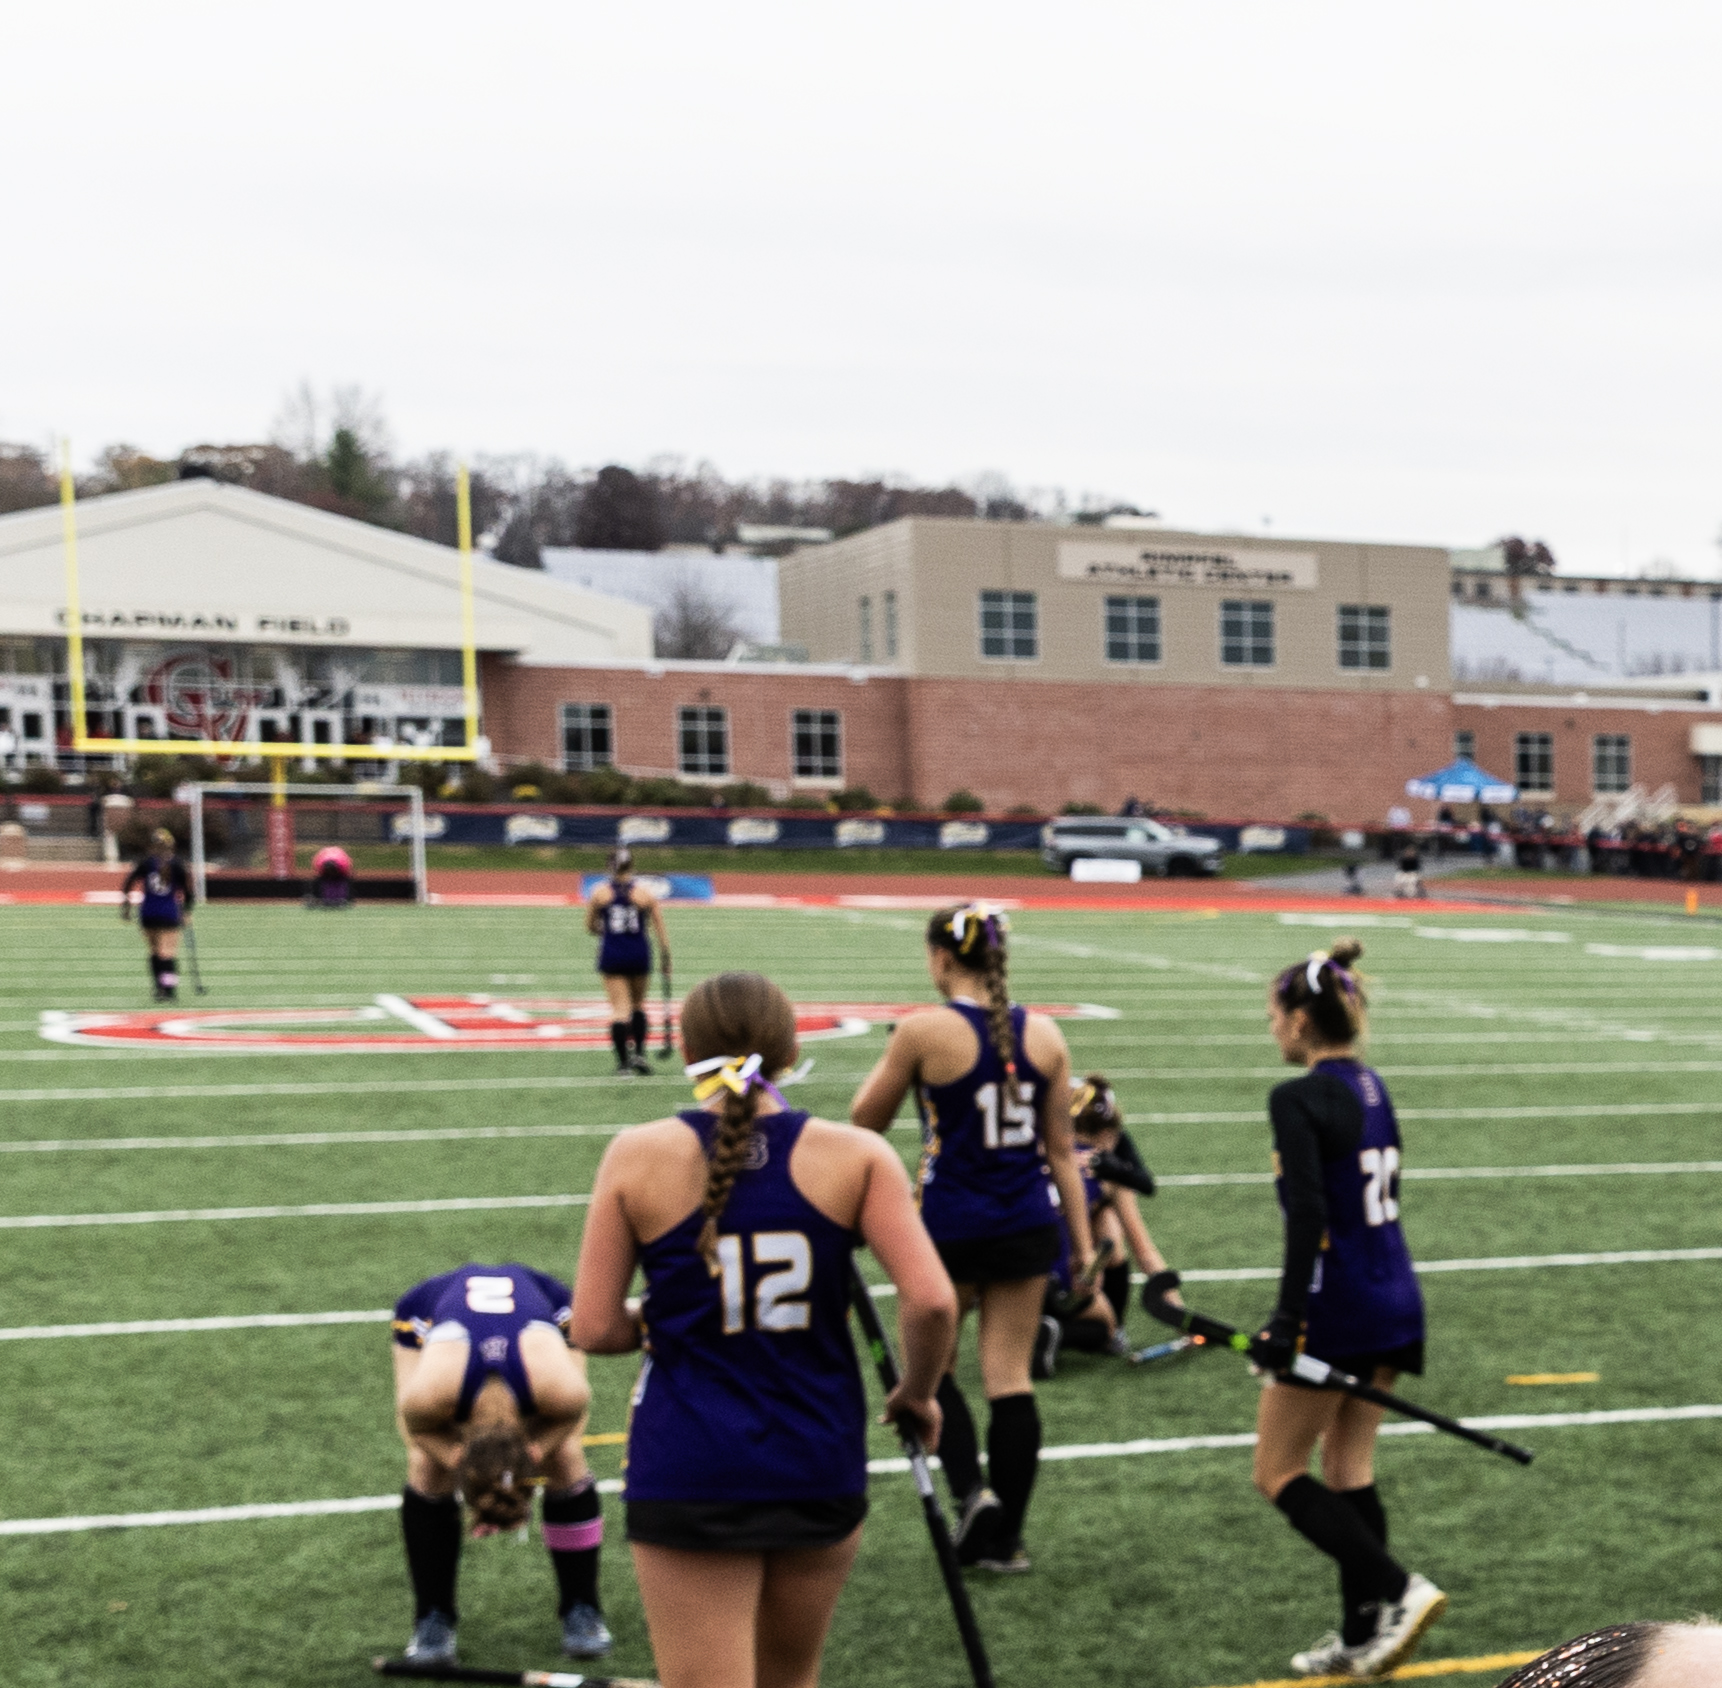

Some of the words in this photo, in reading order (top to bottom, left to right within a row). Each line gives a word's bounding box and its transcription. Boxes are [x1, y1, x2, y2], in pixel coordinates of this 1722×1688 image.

[256, 613, 351, 637] FIELD
[973, 1081, 1037, 1150] 15
[716, 1231, 814, 1335] 12
